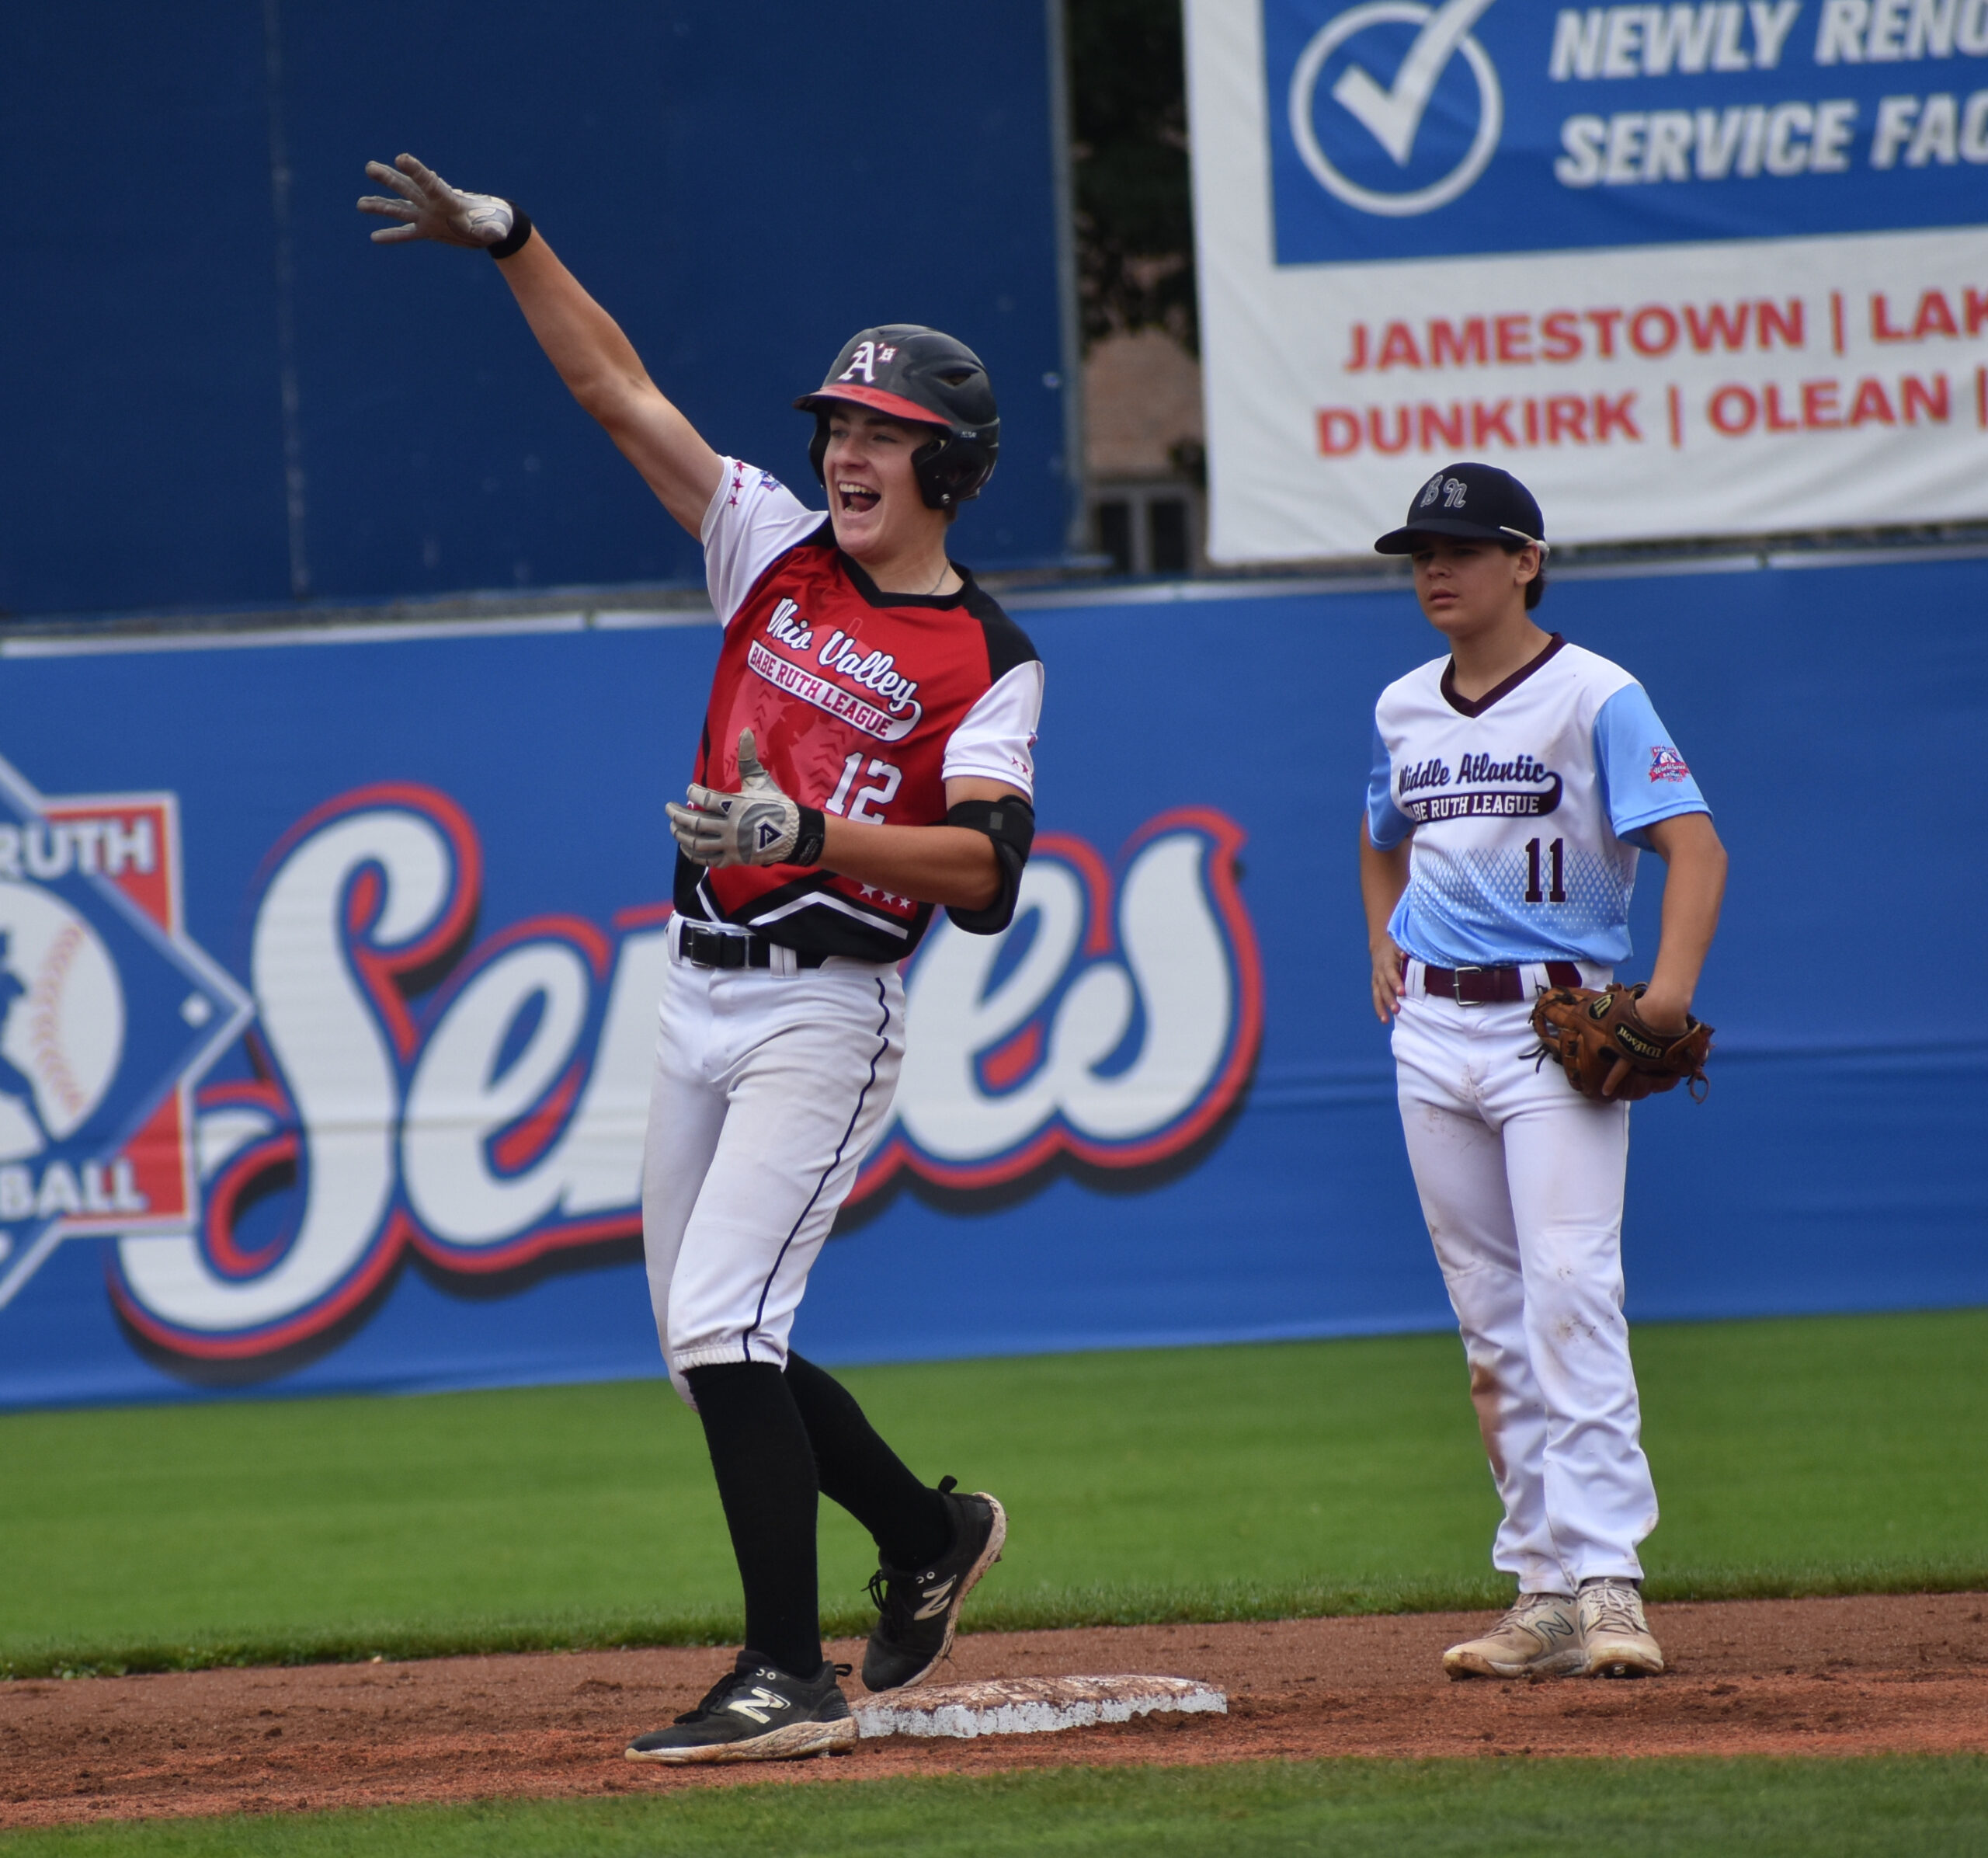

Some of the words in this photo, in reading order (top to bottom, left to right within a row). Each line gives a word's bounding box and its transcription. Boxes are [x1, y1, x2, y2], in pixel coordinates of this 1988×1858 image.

[1551, 0, 1802, 82] NEWLY
[1555, 99, 1858, 189] SERVICE
[1345, 298, 1806, 373] JAMESTOWN
[1315, 391, 1643, 457] DUNKIRK
[1708, 372, 1950, 438] OLEAN
[750, 645, 777, 677] BABE
[775, 663, 822, 700] RUTH
[821, 687, 894, 737] LEAGUE
[818, 629, 919, 713] Valley
[825, 751, 903, 825] 12
[1455, 752, 1544, 785] Atlantic
[1431, 795, 1469, 819] RUTH
[1472, 795, 1540, 814] LEAGUE
[1524, 837, 1566, 903] 11
[1618, 1025, 1663, 1058] Wilson
